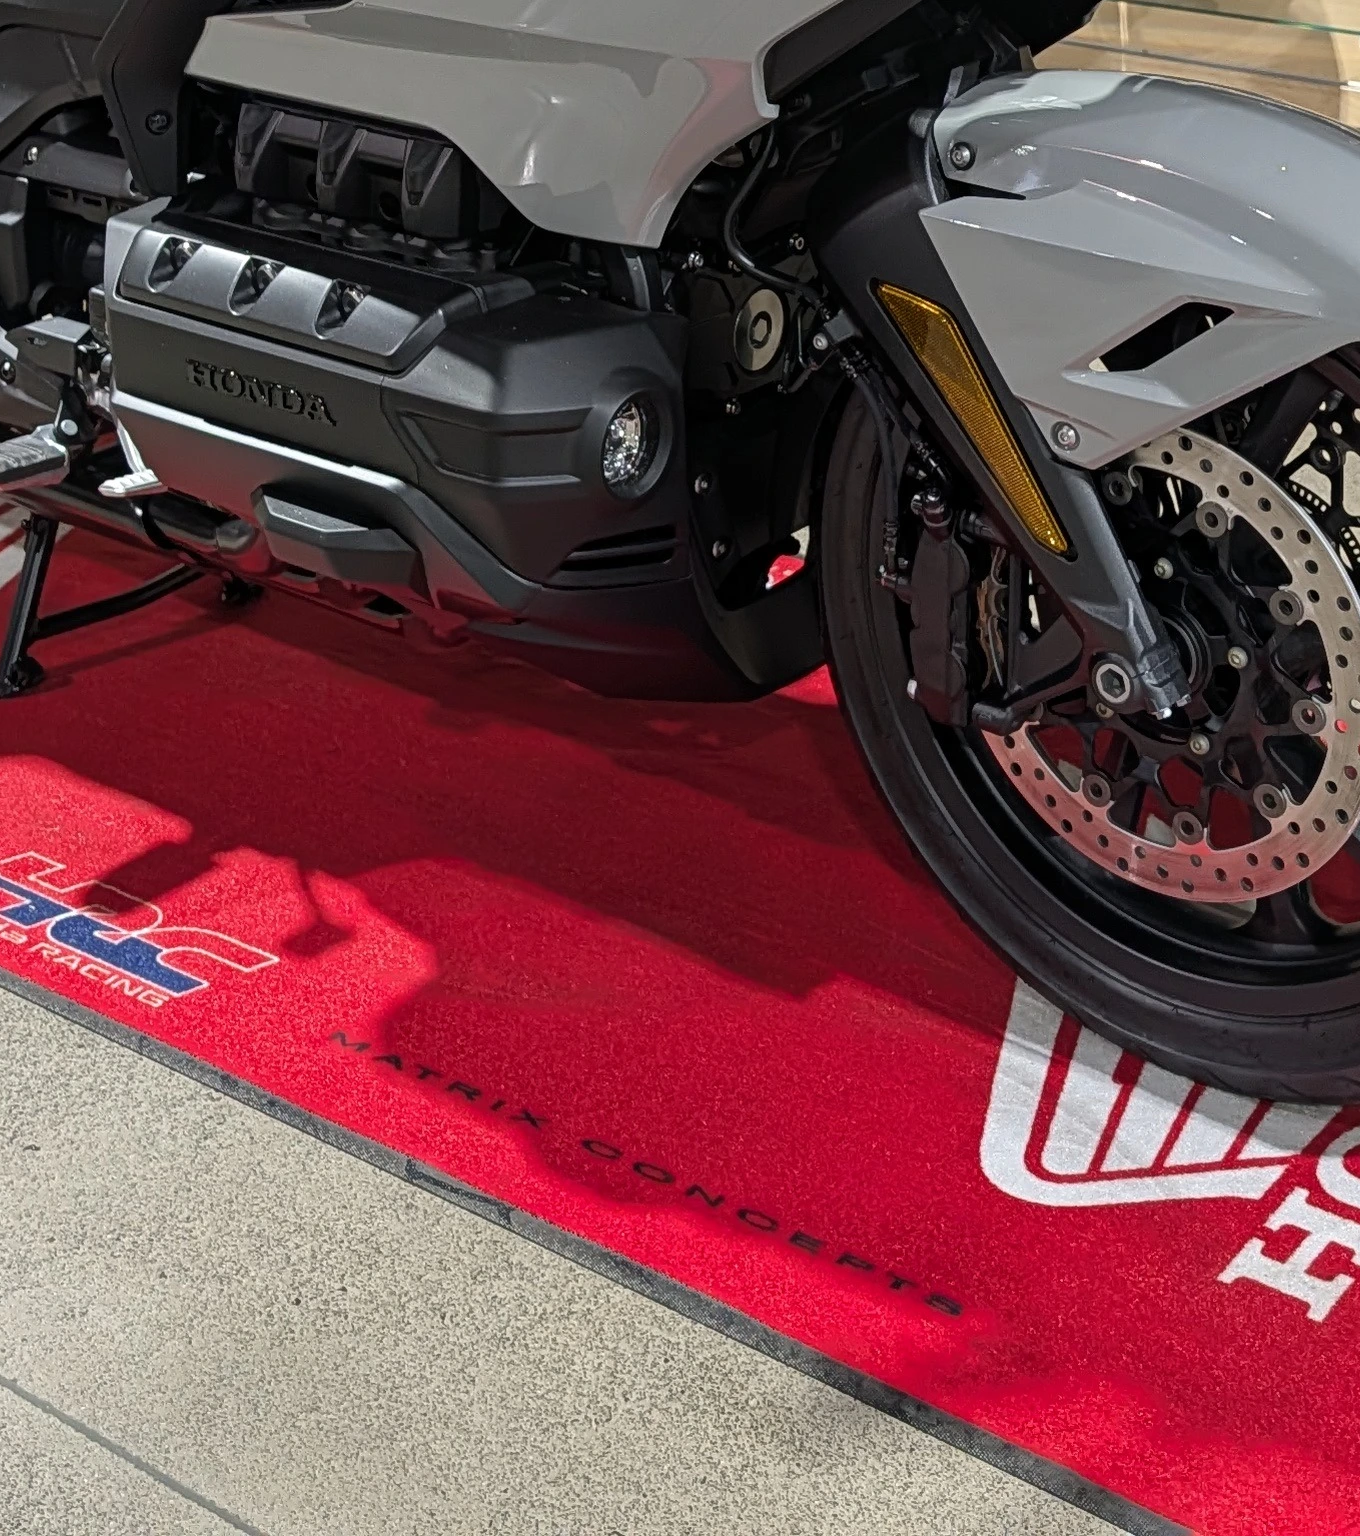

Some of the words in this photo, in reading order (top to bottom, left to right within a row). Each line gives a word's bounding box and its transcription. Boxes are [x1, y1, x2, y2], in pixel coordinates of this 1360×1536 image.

[185, 358, 337, 427] HONDA
[29, 944, 169, 1008] RACING
[328, 1031, 549, 1129] MATRIX
[581, 1137, 964, 1318] CONCEPTS
